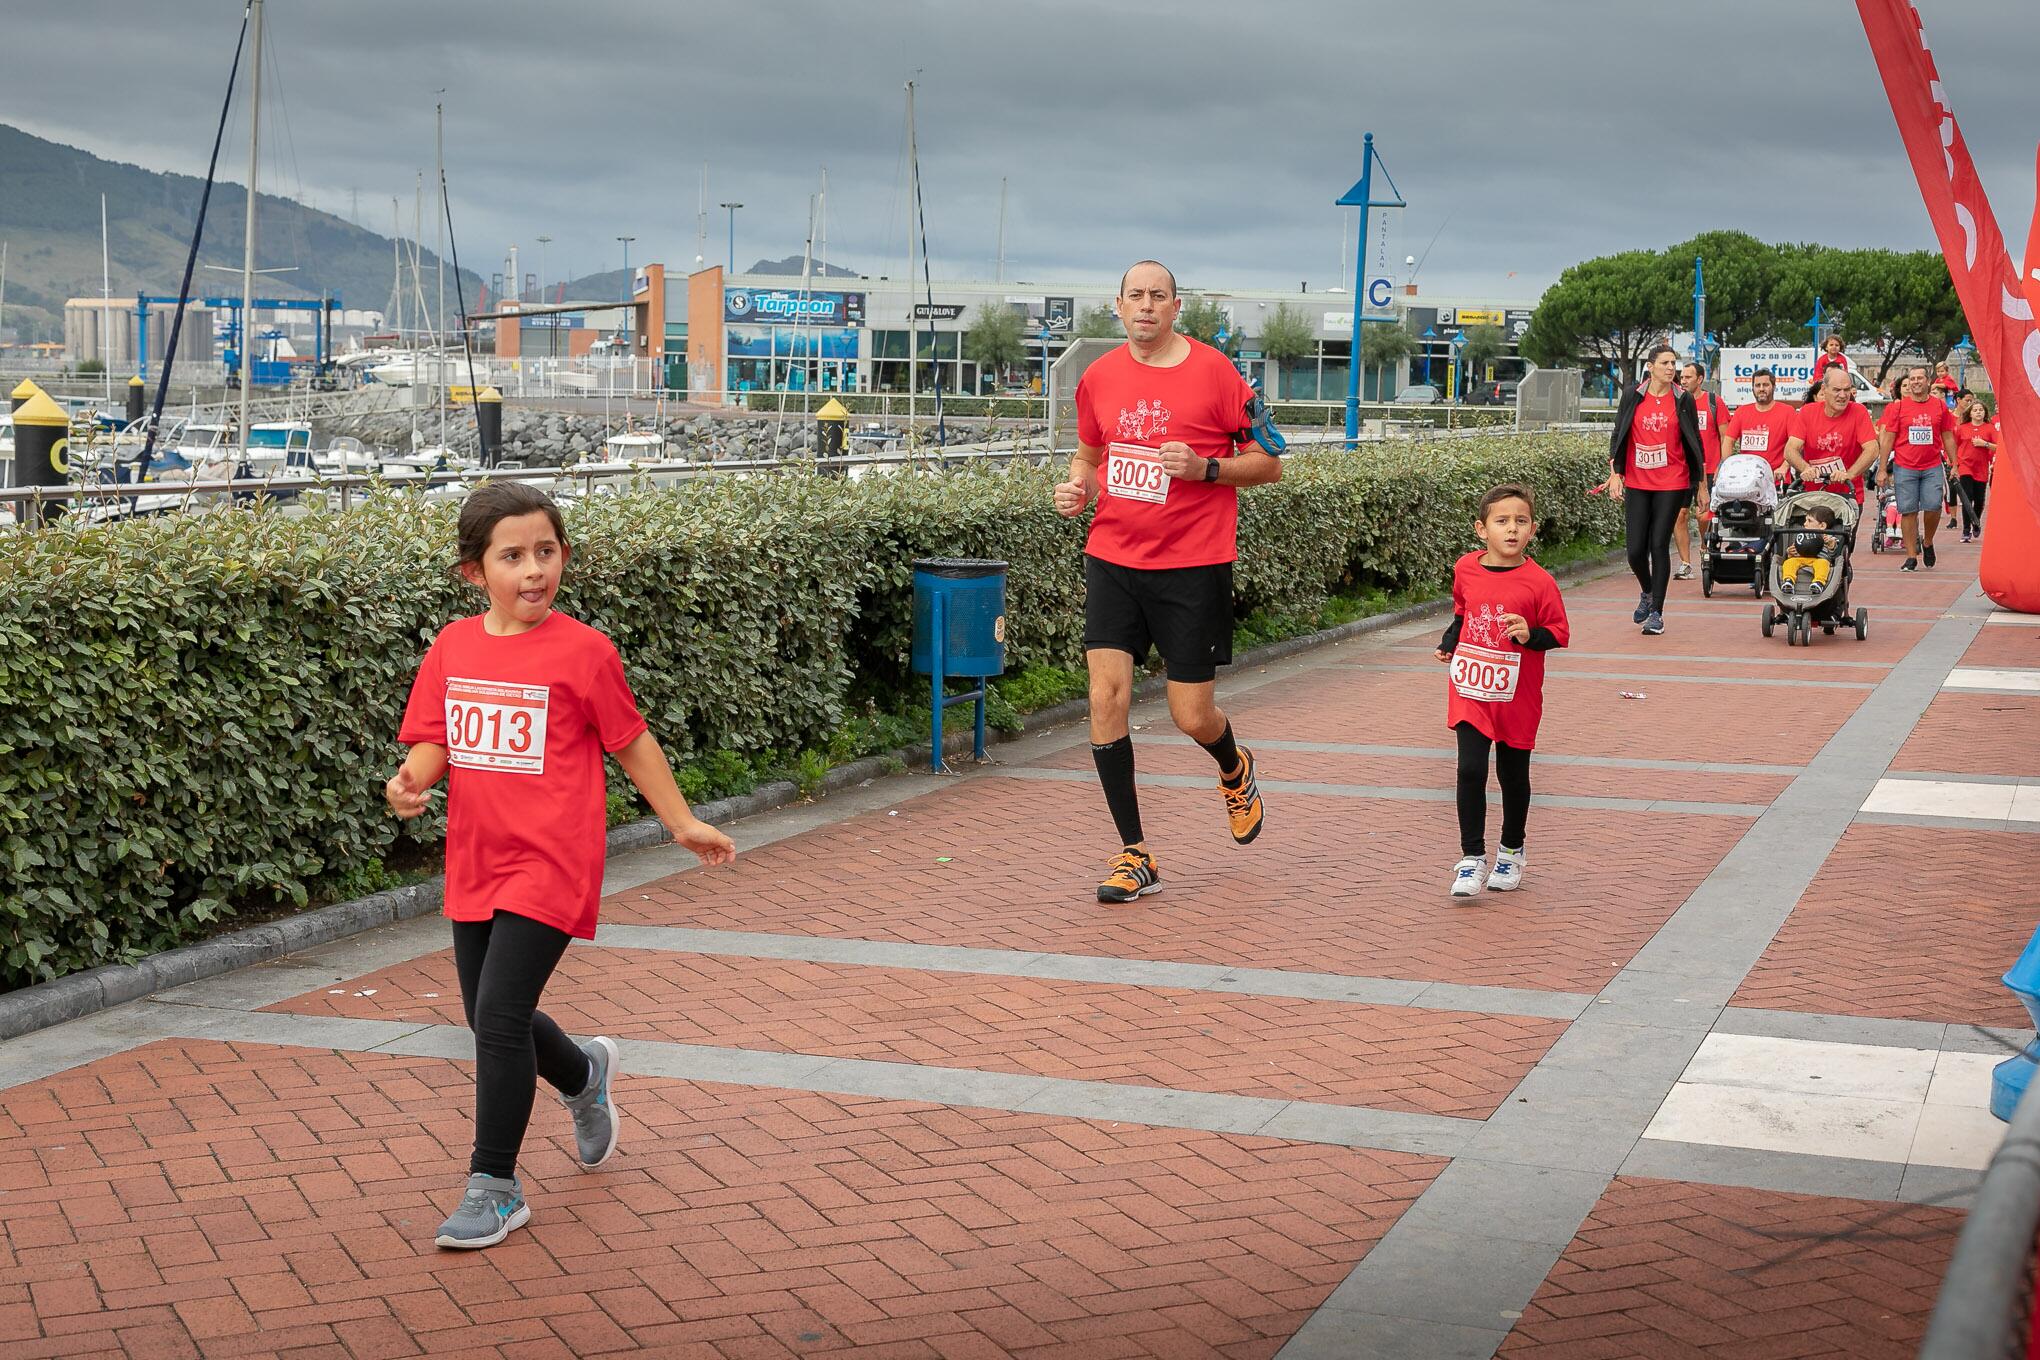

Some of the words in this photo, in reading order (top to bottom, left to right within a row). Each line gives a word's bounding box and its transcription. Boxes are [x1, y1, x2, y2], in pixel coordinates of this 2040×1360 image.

[1368, 278, 1392, 307] C
[754, 294, 836, 317] Tarpoon
[1734, 364, 1815, 380] tefurg
[1744, 435, 1766, 446] 3013
[1911, 431, 1931, 441] 1006
[1638, 451, 1662, 464] 3011
[1112, 459, 1164, 491] 3003
[1454, 658, 1510, 691] 3003
[450, 703, 533, 753] 3013
